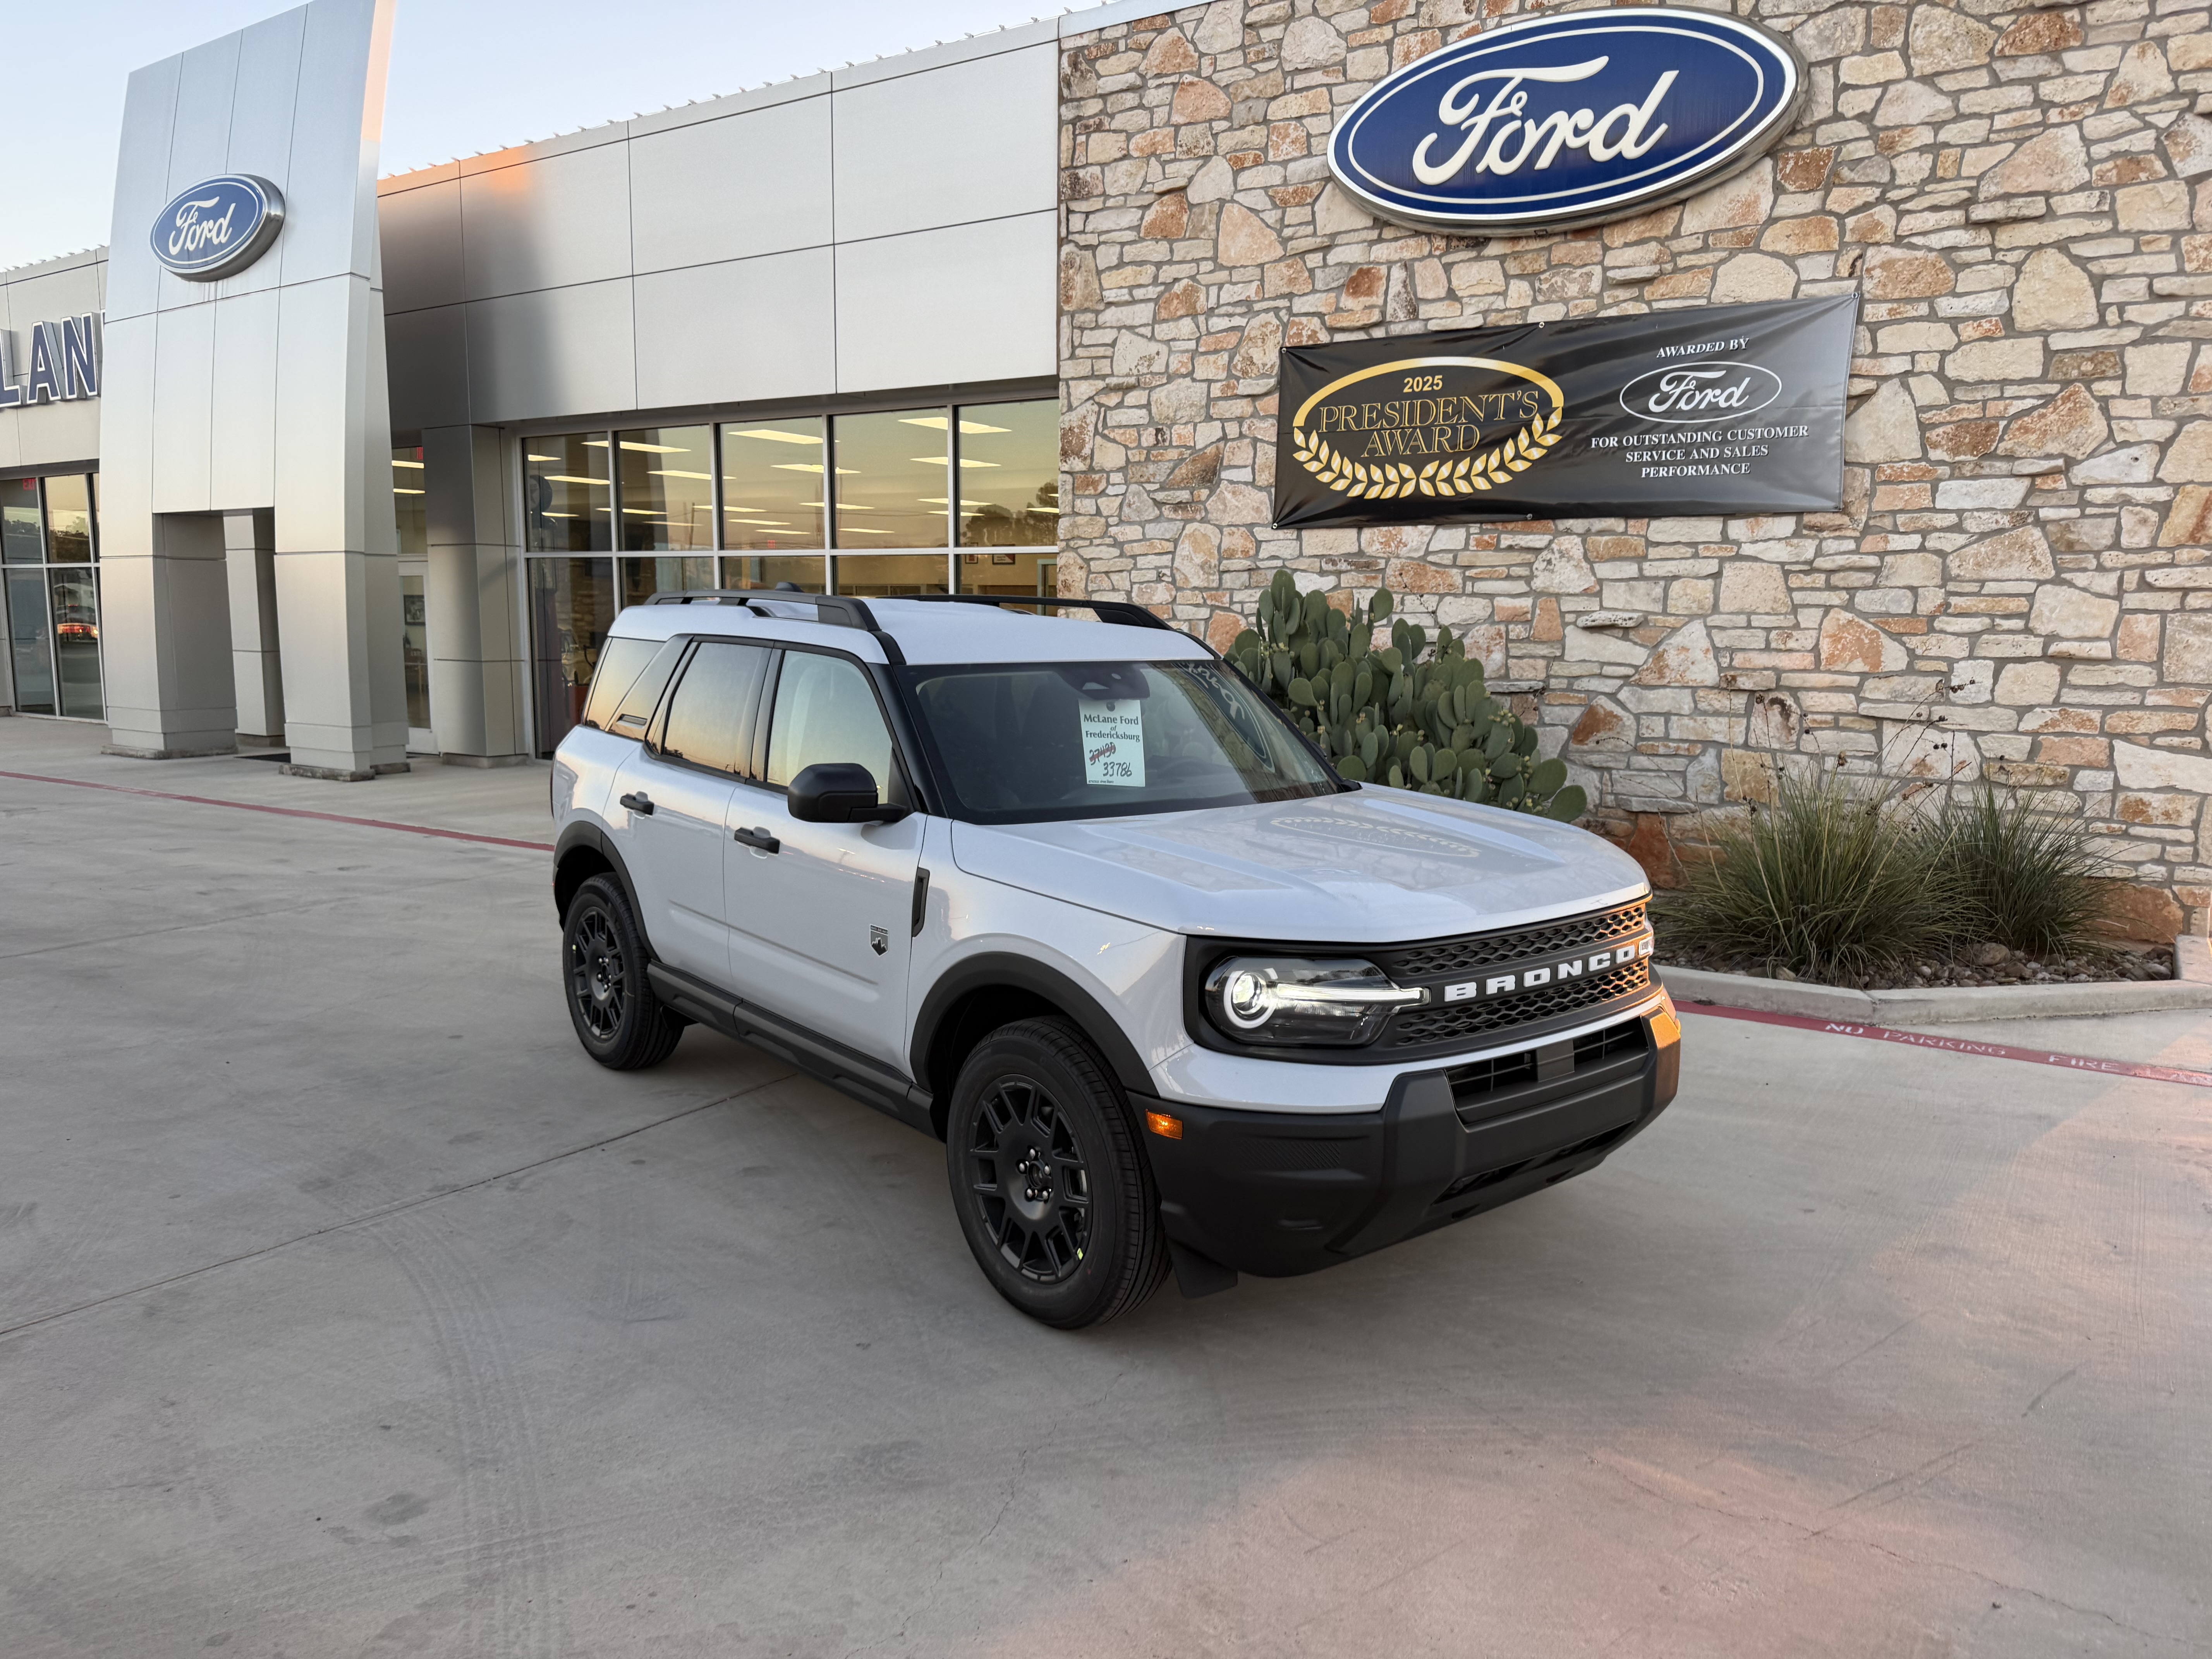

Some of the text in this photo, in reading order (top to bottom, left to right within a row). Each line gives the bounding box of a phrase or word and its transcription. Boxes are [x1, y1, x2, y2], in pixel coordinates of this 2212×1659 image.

[1413, 56, 1679, 185] Ford
[169, 196, 235, 255] Ford
[0, 309, 105, 407] LAN
[1656, 338, 1750, 358] AWARDED BY
[1403, 375, 1443, 393] 2025
[1649, 370, 1751, 412] Ford
[1318, 390, 1539, 433] PRESIDENT'S
[1361, 424, 1480, 457] AWARD
[1591, 425, 1809, 448] FOR OUTSTANDING CUSTOMER
[1625, 445, 1769, 463] SERVICE AND SALES
[1641, 463, 1750, 478] PERFORMANCE
[1084, 714, 1139, 725] McLane Ford
[1085, 730, 1140, 742] Fredericksburg
[1103, 761, 1132, 777] 33786
[1444, 945, 1635, 1002] BRONCO
[1825, 1023, 1864, 1034] NO
[1884, 1031, 2006, 1055] PARKING
[2049, 1055, 2120, 1072] FIRE
